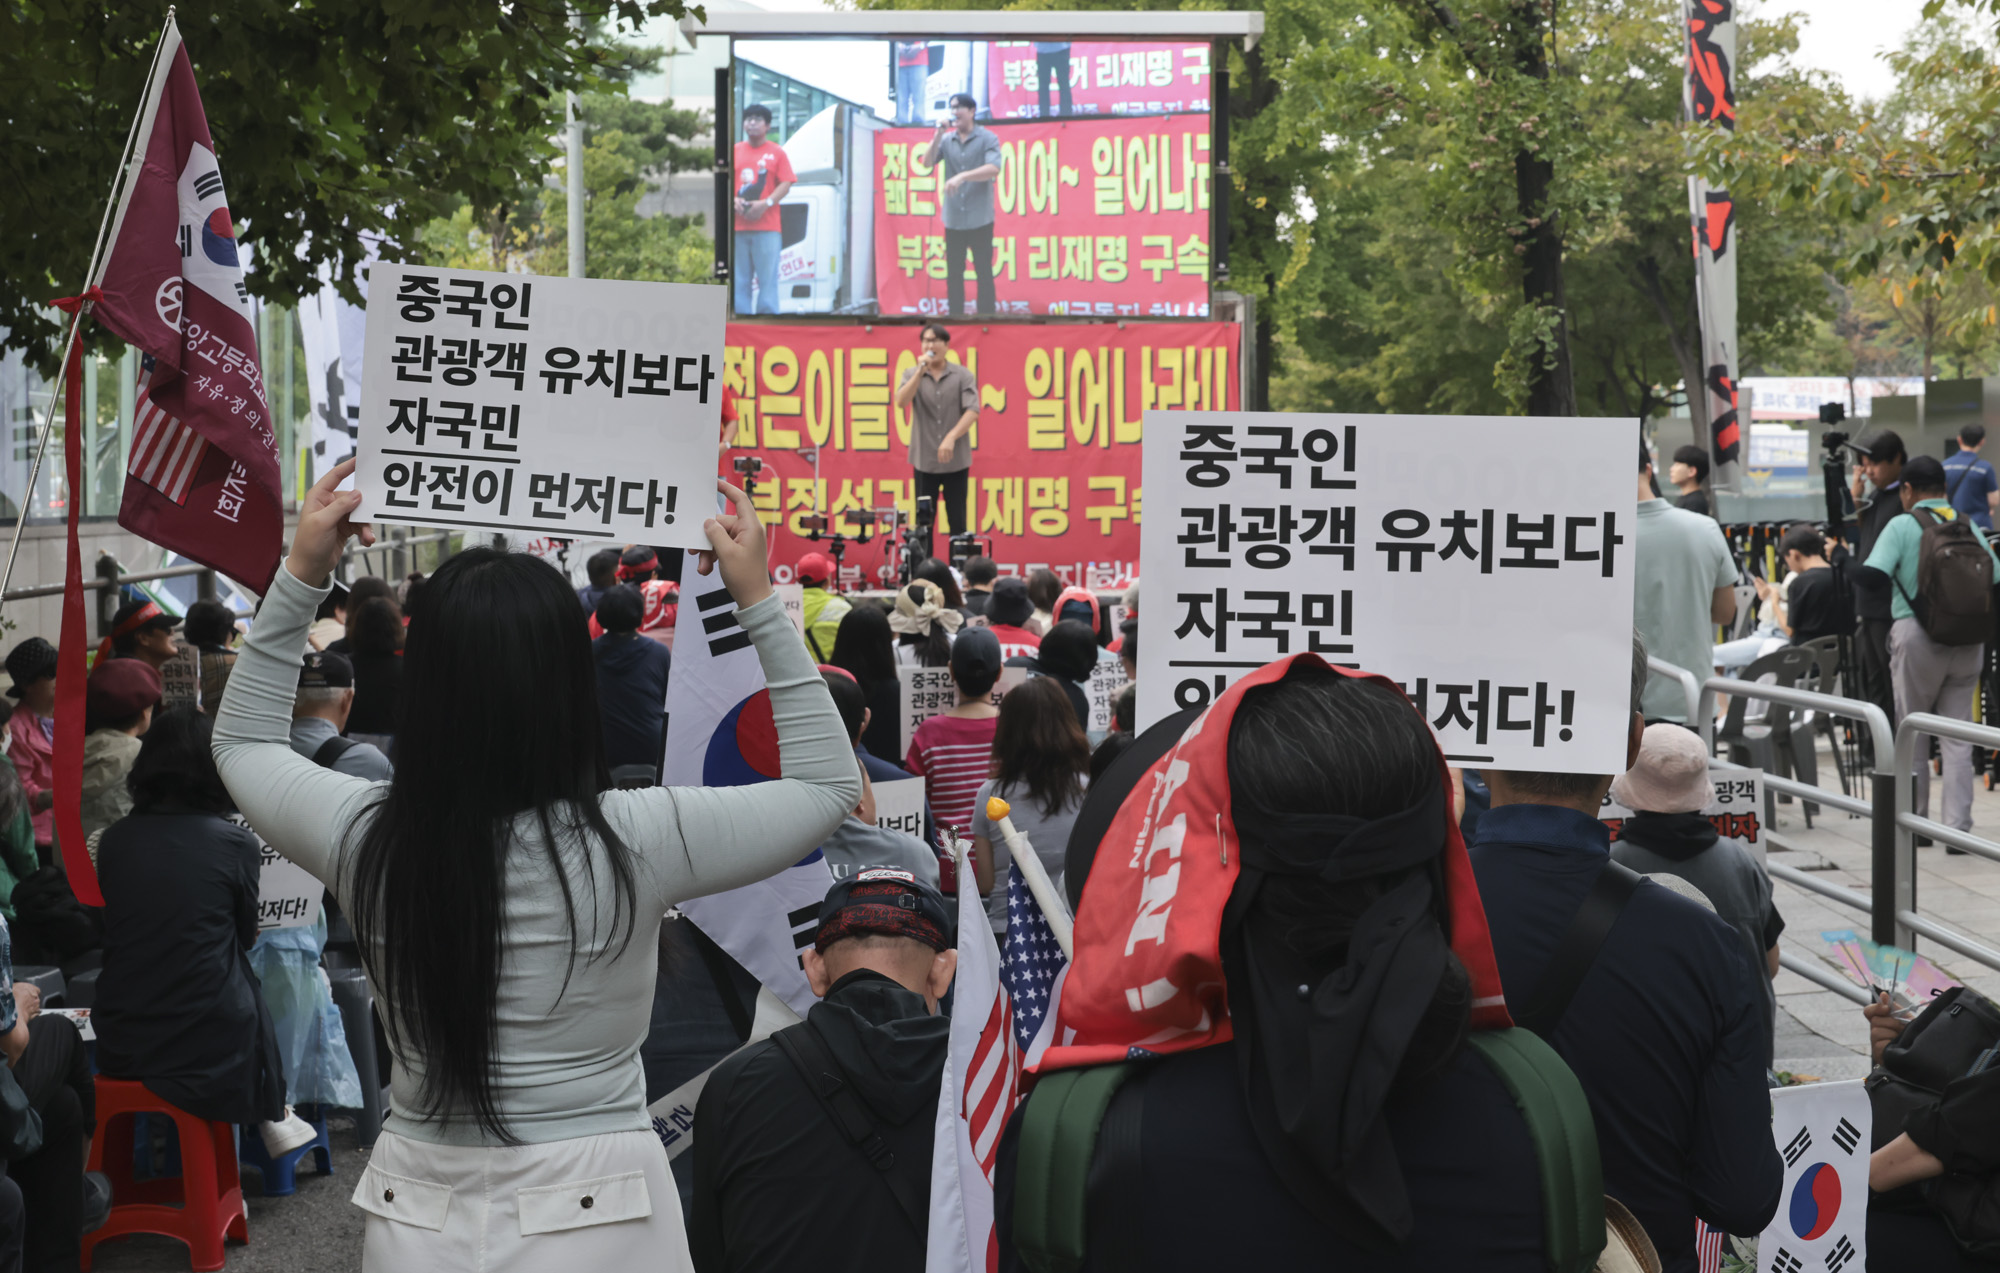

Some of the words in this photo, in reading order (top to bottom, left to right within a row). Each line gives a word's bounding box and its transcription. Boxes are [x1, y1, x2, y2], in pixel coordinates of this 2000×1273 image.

[1003, 55, 1088, 92] 부정거
[1095, 48, 1174, 88] 리재명
[897, 235, 1017, 283] 부정거
[1029, 235, 1128, 283] 리재명
[396, 274, 532, 331] 중국인
[391, 335, 528, 391] 관광객
[539, 346, 715, 404] 유치보다
[386, 397, 521, 452] 자국민
[1179, 424, 1358, 490] 중국인
[382, 461, 514, 517] 안전이
[528, 472, 678, 528] 먼저다!
[1086, 476, 1140, 528] 구
[1176, 504, 1357, 571] 관광객
[1375, 508, 1624, 578] 유치보다
[1173, 588, 1354, 654] 자국민
[911, 672, 955, 690] 중국인
[911, 690, 955, 709] 관광객
